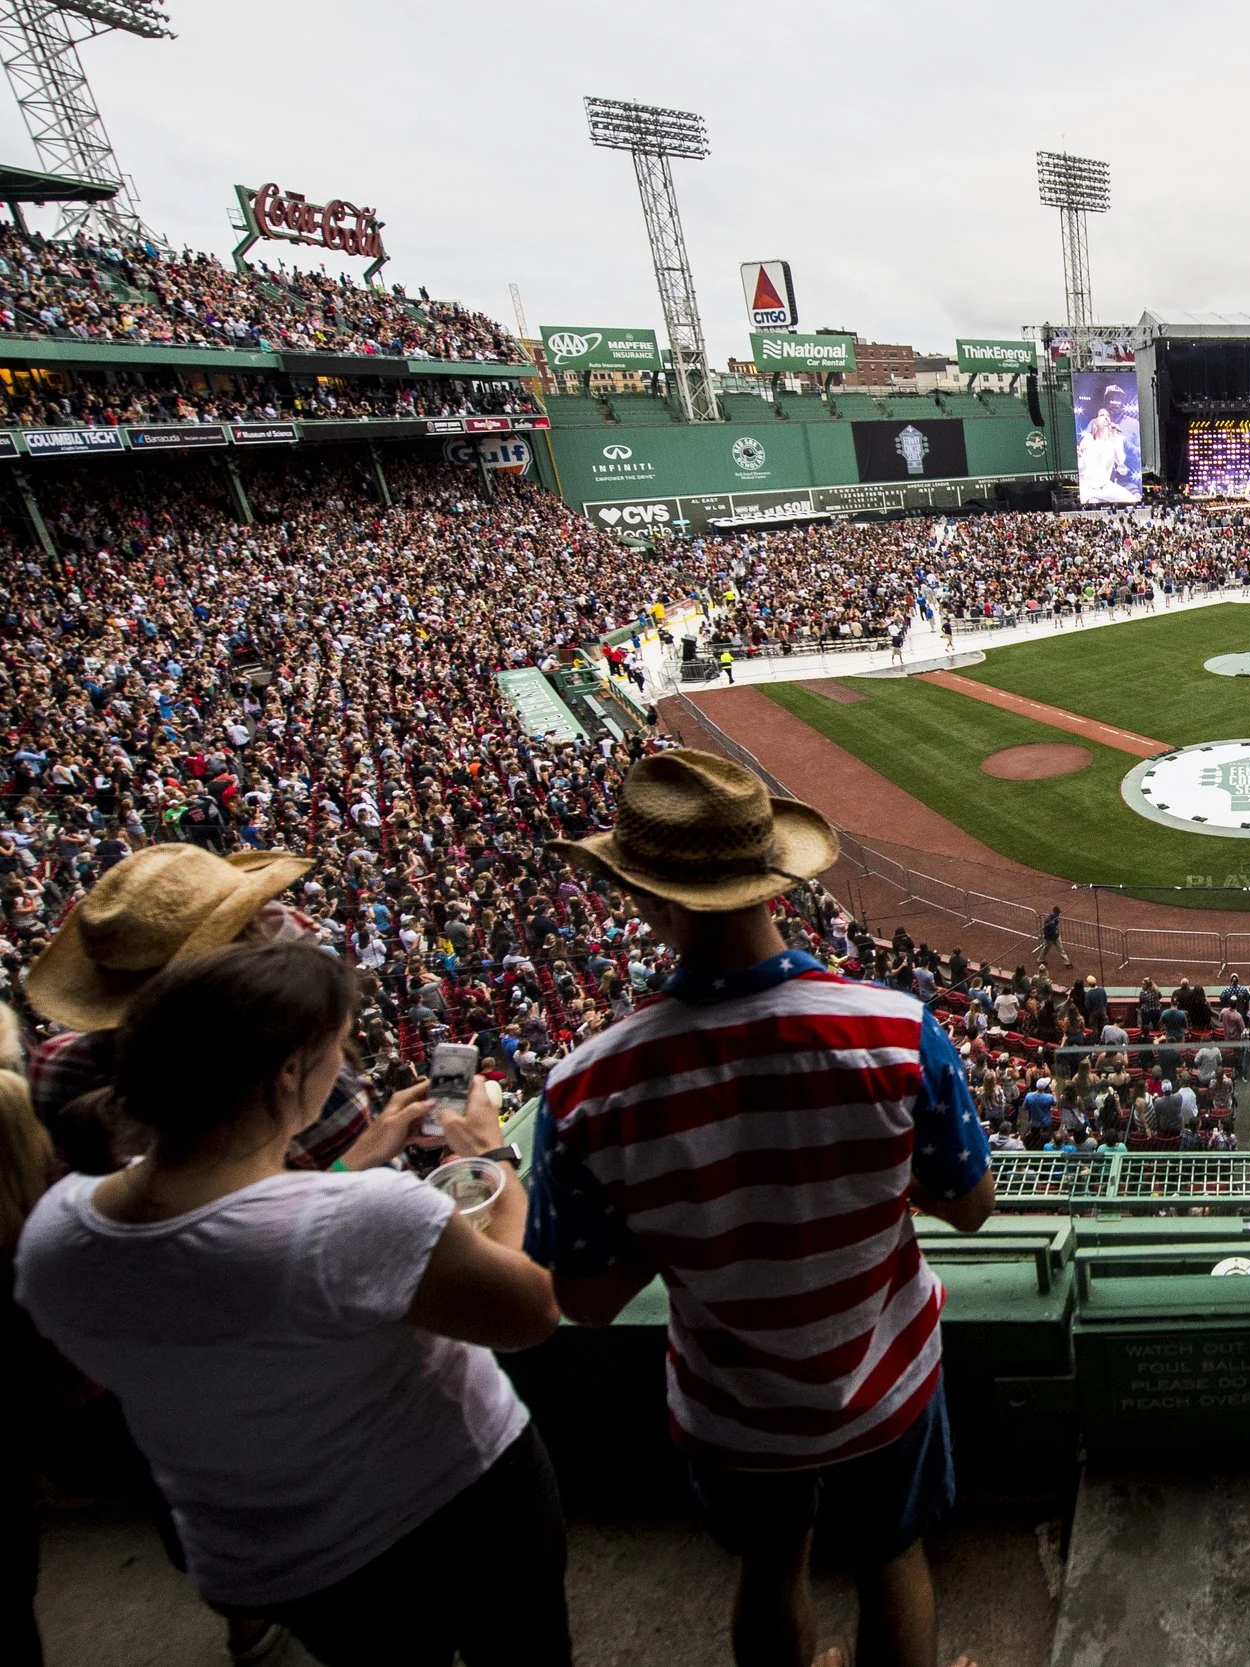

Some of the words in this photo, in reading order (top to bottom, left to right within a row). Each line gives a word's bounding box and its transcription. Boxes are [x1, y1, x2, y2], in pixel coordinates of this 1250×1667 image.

[255, 183, 381, 258] Coca-Cola
[753, 311, 787, 324] CITGO
[553, 333, 585, 356] AAA
[607, 341, 655, 350] MAPFRE
[612, 351, 654, 359] INSURANCE
[26, 433, 84, 447] COLUMBIA
[81, 432, 116, 444] TECH
[144, 435, 181, 443] Barracuda
[449, 444, 525, 464] Gulf
[592, 463, 652, 473] INFINITI
[622, 504, 670, 524] CVS
[764, 501, 811, 515] MASON
[1125, 1344, 1193, 1356] WATCH
[1203, 1342, 1243, 1353] OUT
[1137, 1361, 1191, 1374] FOUL
[1131, 1378, 1209, 1392] PLEASE
[1218, 1376, 1247, 1388] DO
[1121, 1397, 1190, 1410] REACH
